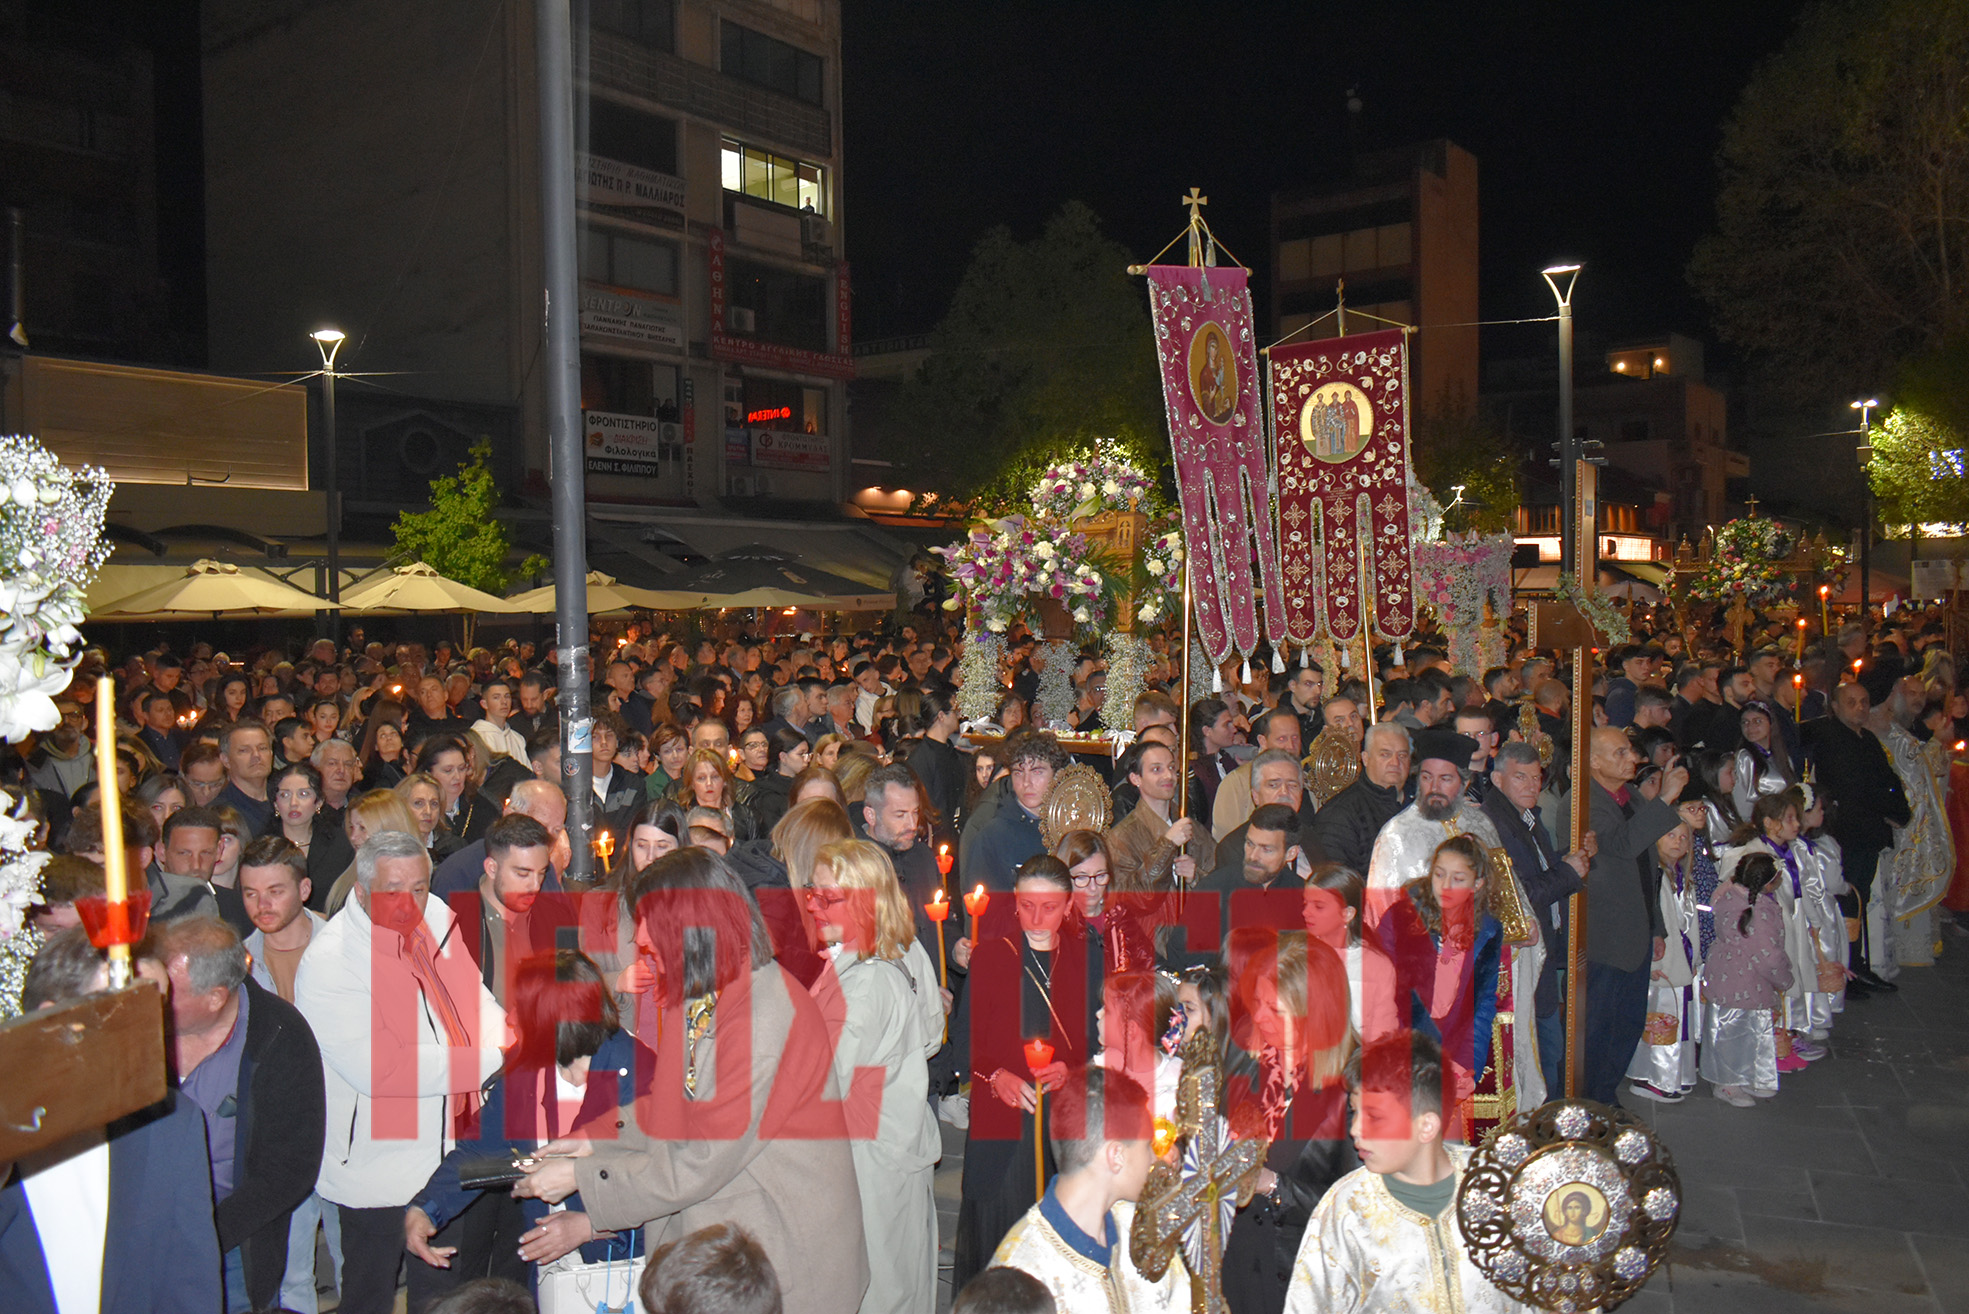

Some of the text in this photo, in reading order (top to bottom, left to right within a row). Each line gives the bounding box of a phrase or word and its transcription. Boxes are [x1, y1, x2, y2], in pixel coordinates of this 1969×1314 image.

[635, 183, 685, 208] ΜΑΛΛΙΑΡΟΣ
[711, 255, 723, 332] ΑΘΗΝΑ
[839, 278, 849, 355] ENGLISH
[713, 336, 756, 350] ΚΕΝΤΡΟ
[760, 343, 808, 358] ΑΓΓΛΙΚΗΣ
[813, 352, 854, 366] ΓΛΩΣΣΑΣ
[588, 414, 657, 432] ΦΡΟΝΤΙΣΤΗΡΙΟ
[604, 445, 656, 460] Φιλολογικά
[588, 459, 657, 475] ΕΛΕΝΗ Σ. ΦΙΛΙΠΠΟΥ
